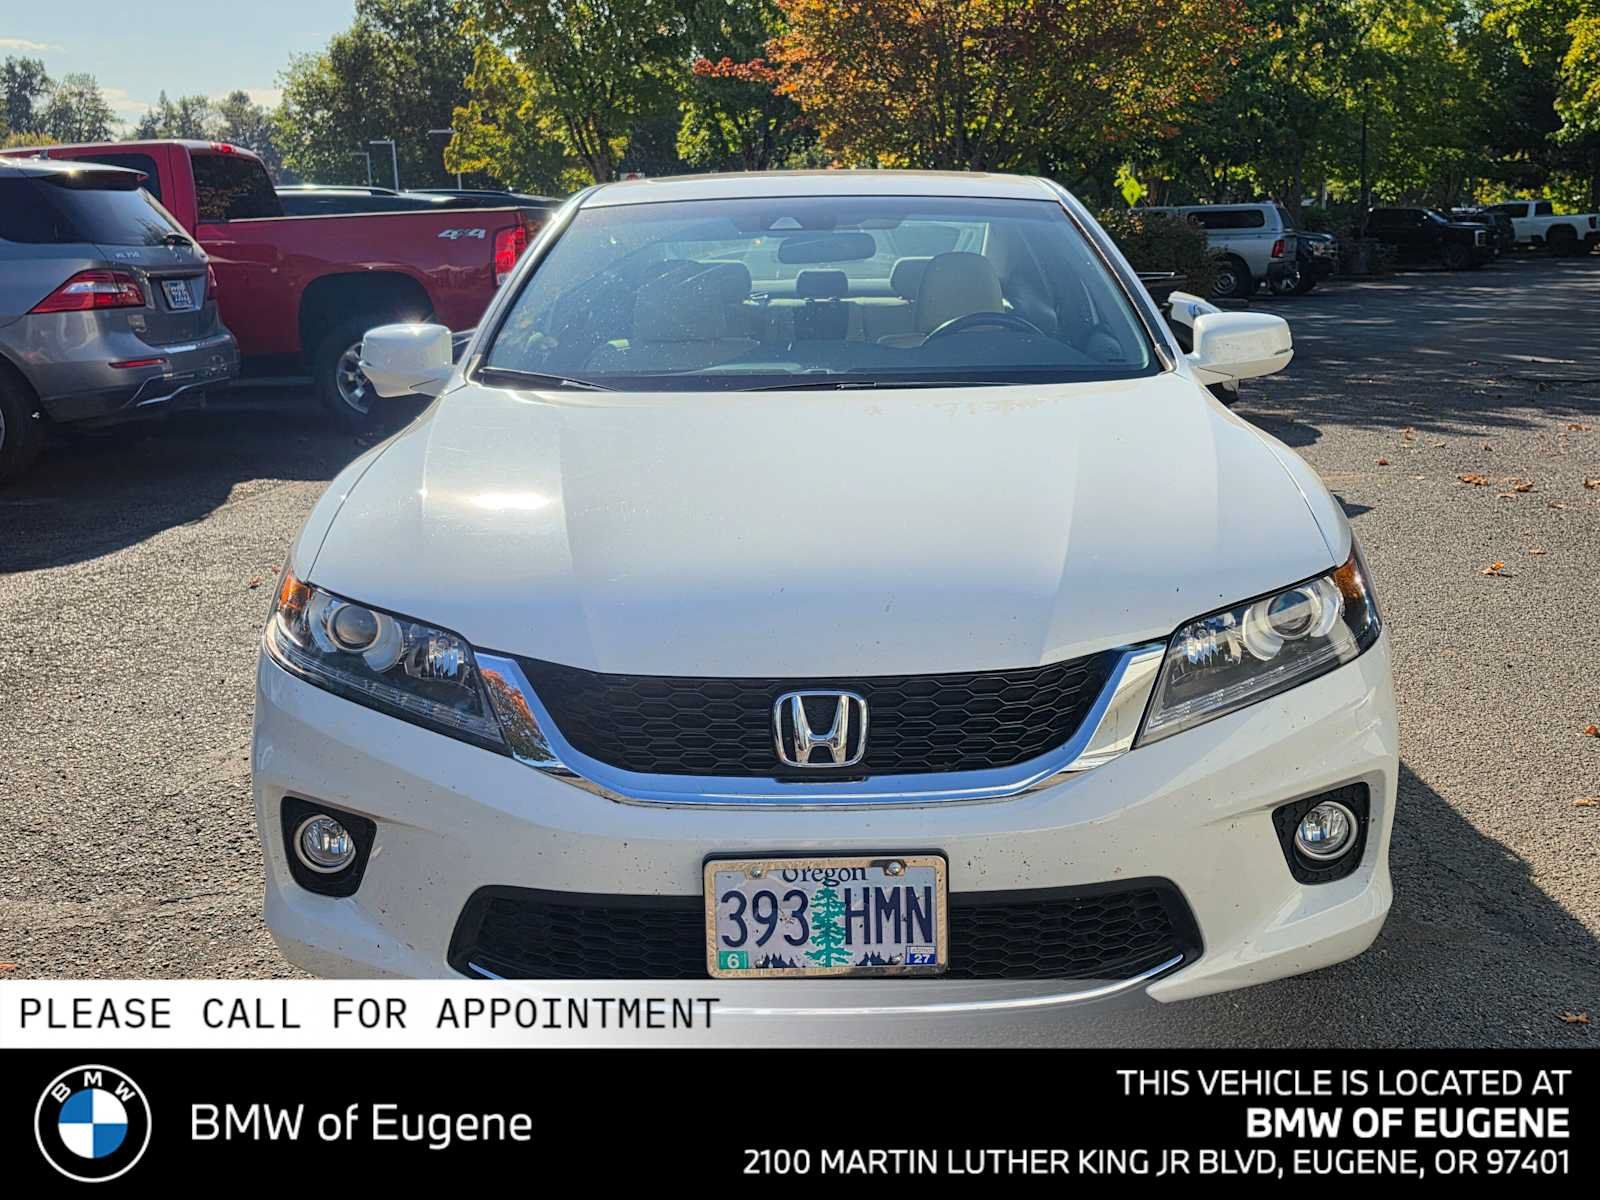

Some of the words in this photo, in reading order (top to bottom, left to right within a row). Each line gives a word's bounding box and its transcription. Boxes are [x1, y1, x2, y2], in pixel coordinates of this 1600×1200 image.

[782, 867, 867, 887] Oregon
[721, 889, 810, 947] 393
[844, 886, 933, 944] HMN
[727, 954, 739, 968] 6
[914, 954, 930, 964] 27
